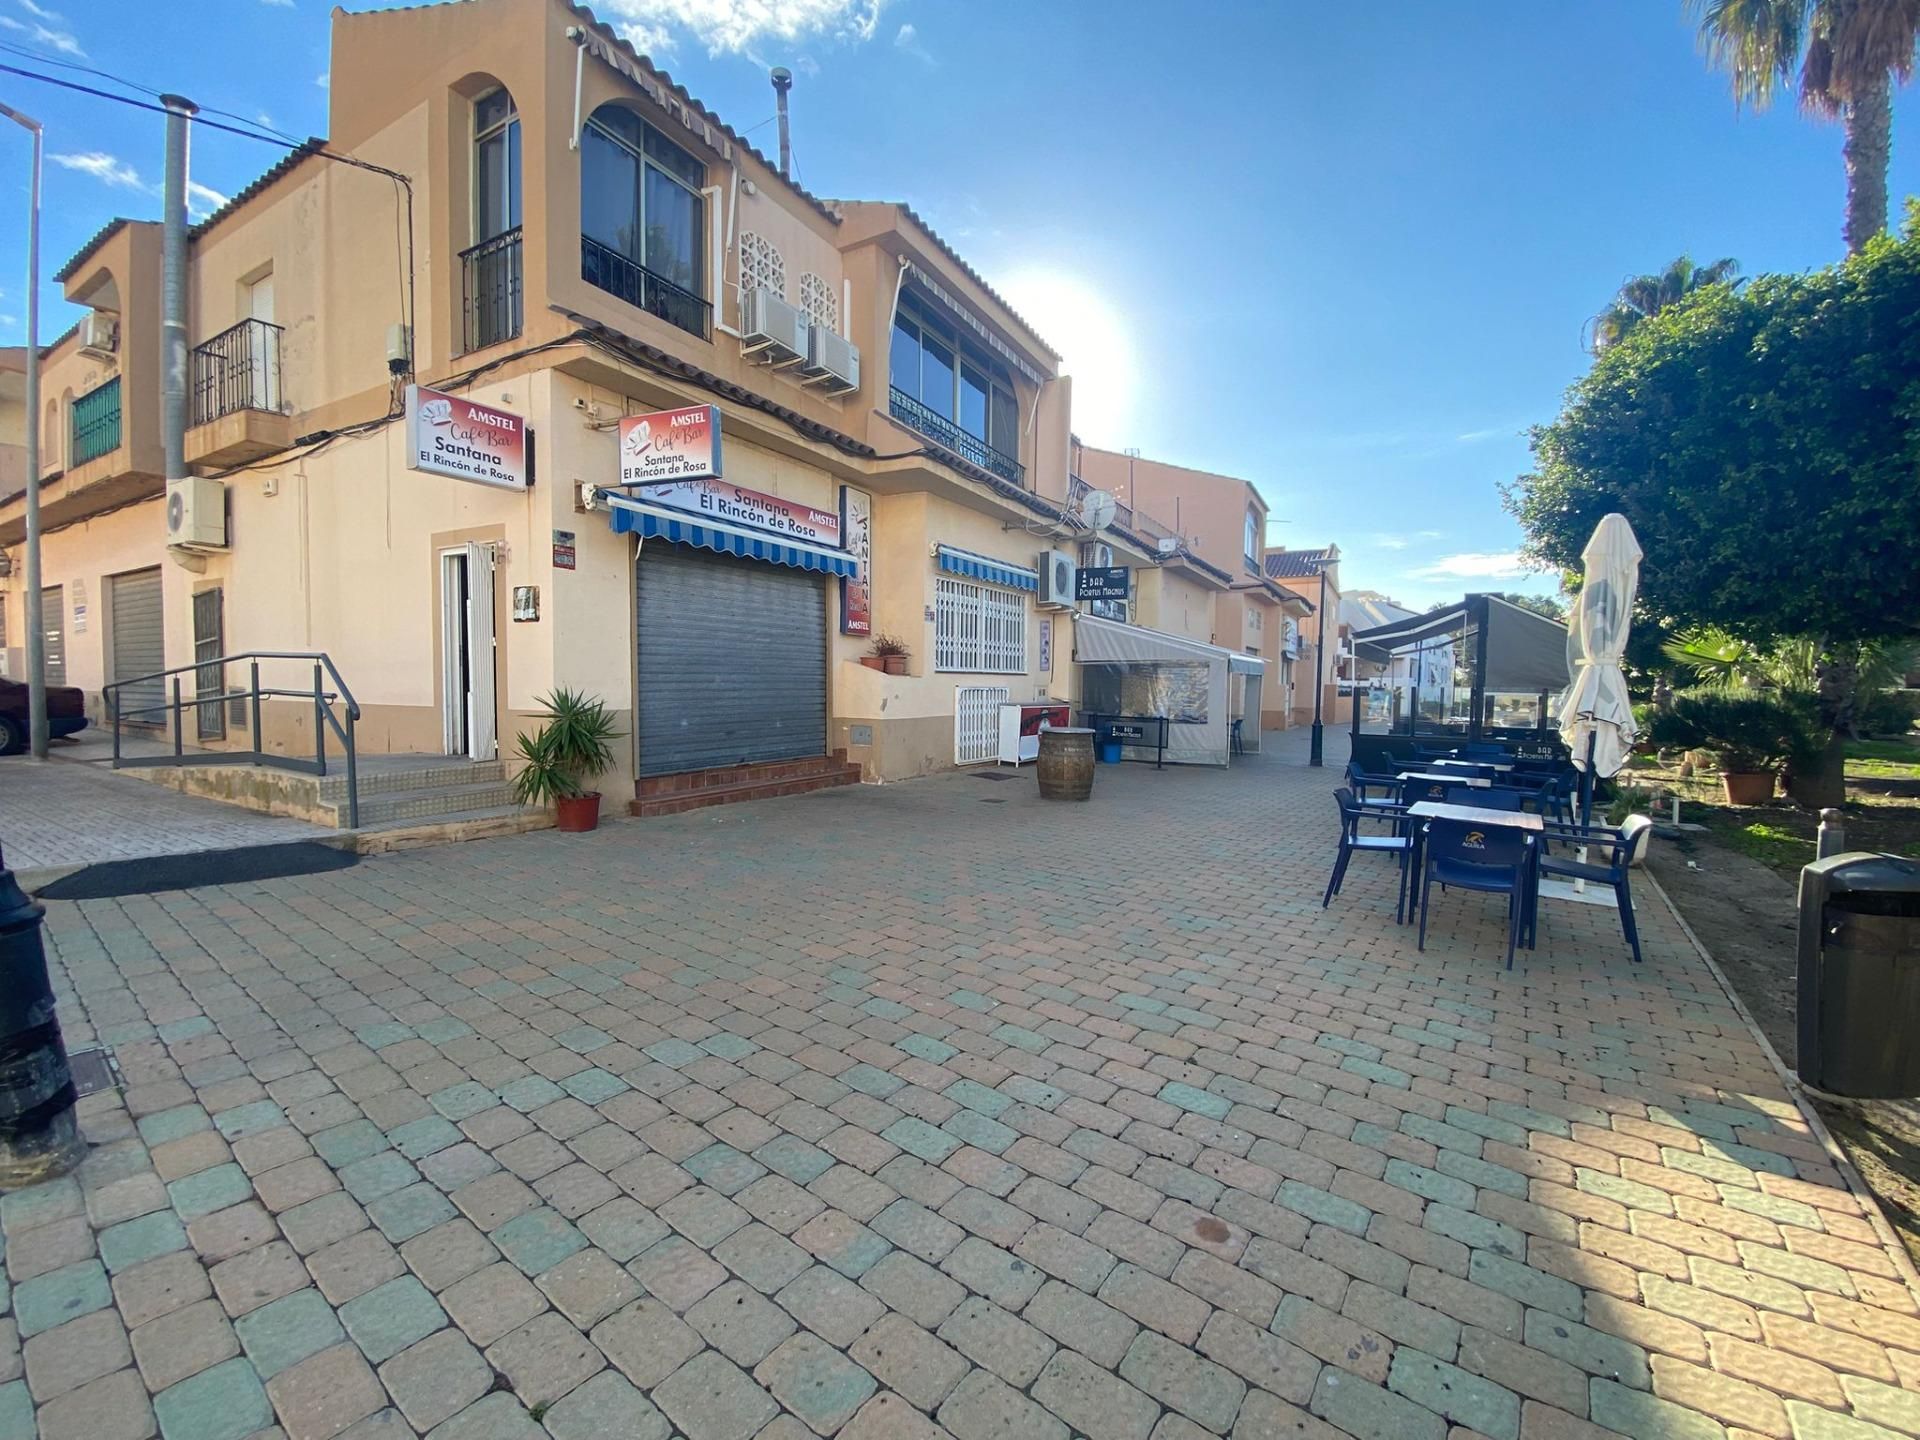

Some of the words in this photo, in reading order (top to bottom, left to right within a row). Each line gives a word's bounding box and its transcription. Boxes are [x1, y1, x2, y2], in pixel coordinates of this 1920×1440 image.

[468, 408, 516, 431] AMSTEL
[670, 412, 706, 428] AMSTEL
[485, 430, 513, 446] Bar
[682, 426, 704, 444] Bar
[435, 436, 502, 466] Santana
[420, 451, 430, 462] El
[434, 453, 471, 471] Rincón
[474, 464, 487, 475] de
[490, 468, 515, 482] Rosa
[644, 455, 685, 466] Santana
[623, 468, 632, 479] El
[634, 465, 666, 478] Rincón
[668, 463, 681, 474] de
[683, 461, 707, 472] Rosa
[734, 488, 790, 517] Santana
[700, 494, 713, 510] El
[718, 498, 765, 524] Rincón
[768, 513, 784, 529] de
[788, 517, 816, 538] Rosa
[808, 510, 837, 529] AMSTEL
[861, 519, 869, 614] SANTANA
[1089, 577, 1105, 587] BAR
[847, 619, 869, 631] AMSTEL
